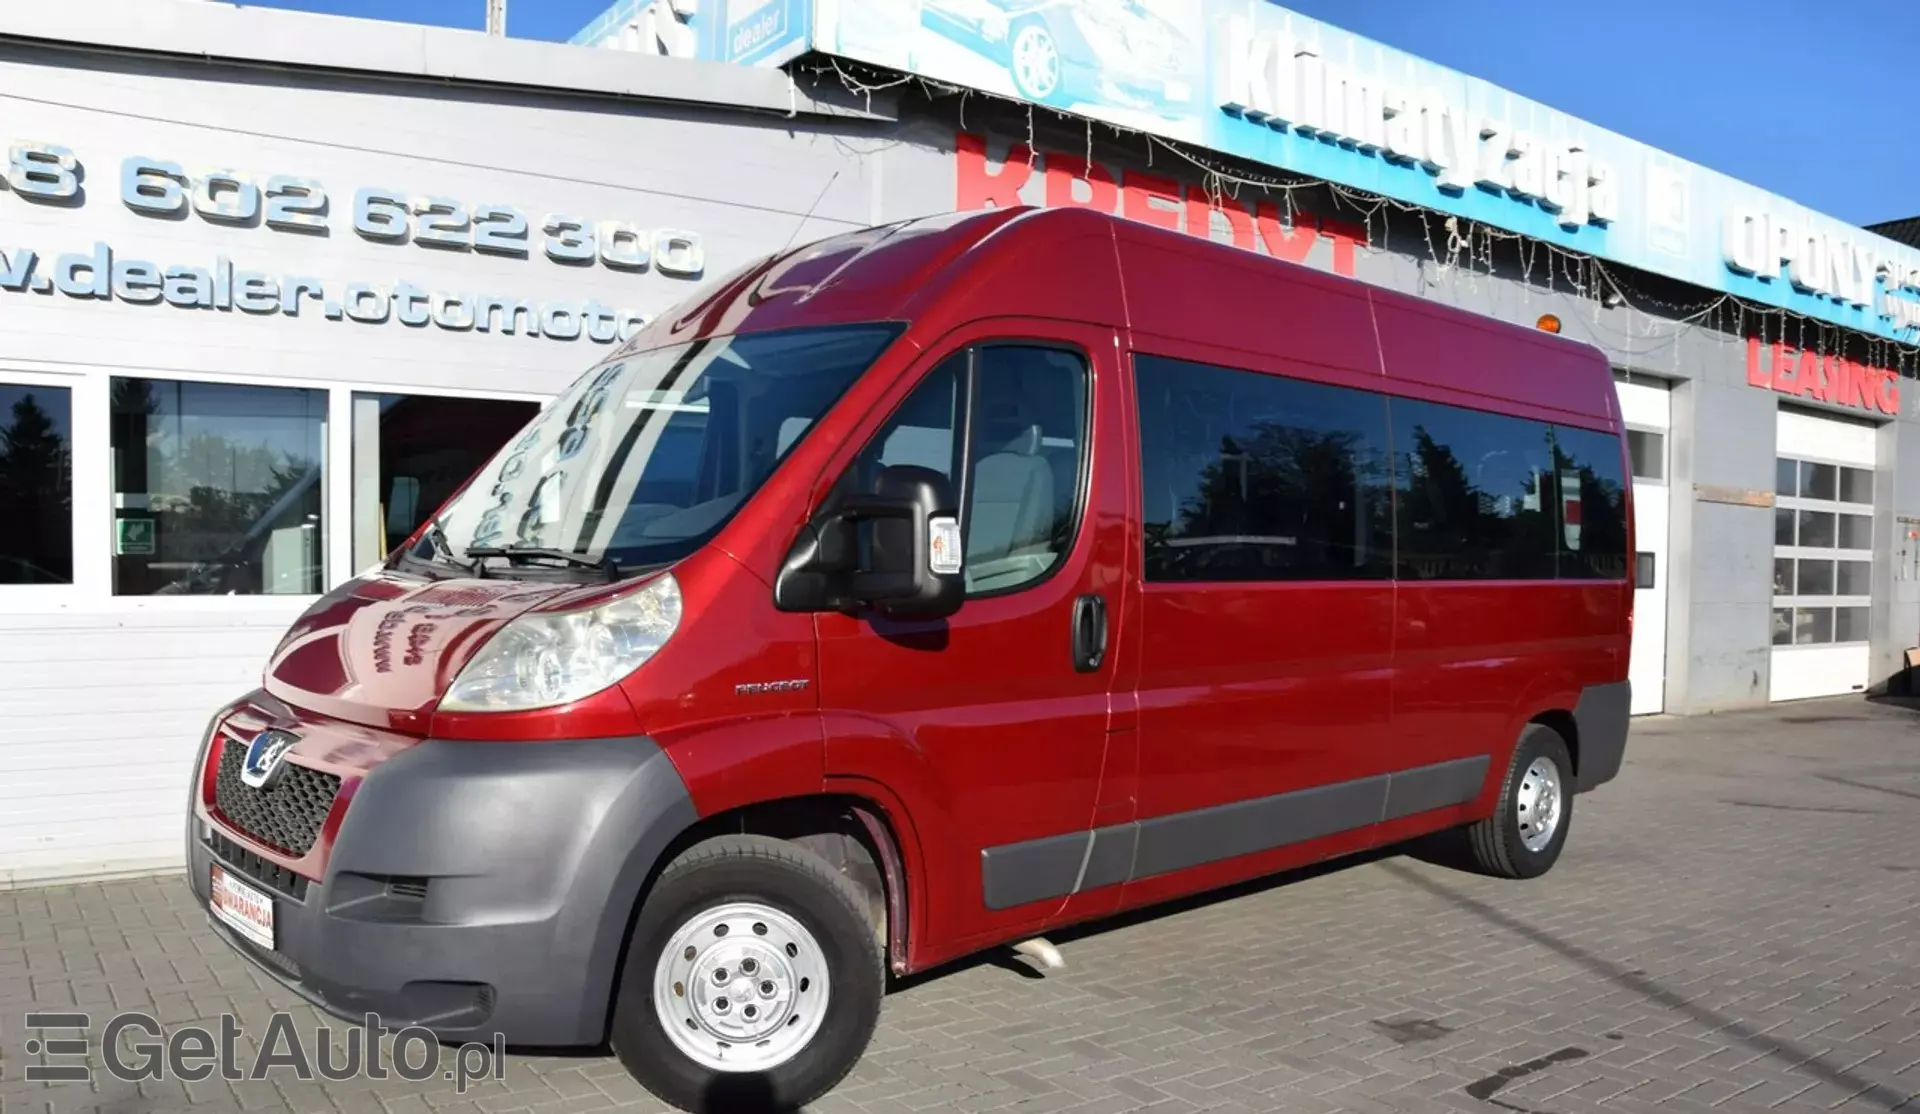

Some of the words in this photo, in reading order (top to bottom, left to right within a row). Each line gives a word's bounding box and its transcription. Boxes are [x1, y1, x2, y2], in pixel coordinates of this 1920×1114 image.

[733, 9, 781, 56] dealer
[120, 155, 330, 236] 602
[352, 186, 530, 259] 622
[541, 211, 706, 281] 300
[1722, 203, 1877, 310] OPONY
[1745, 335, 1900, 415] LEASING
